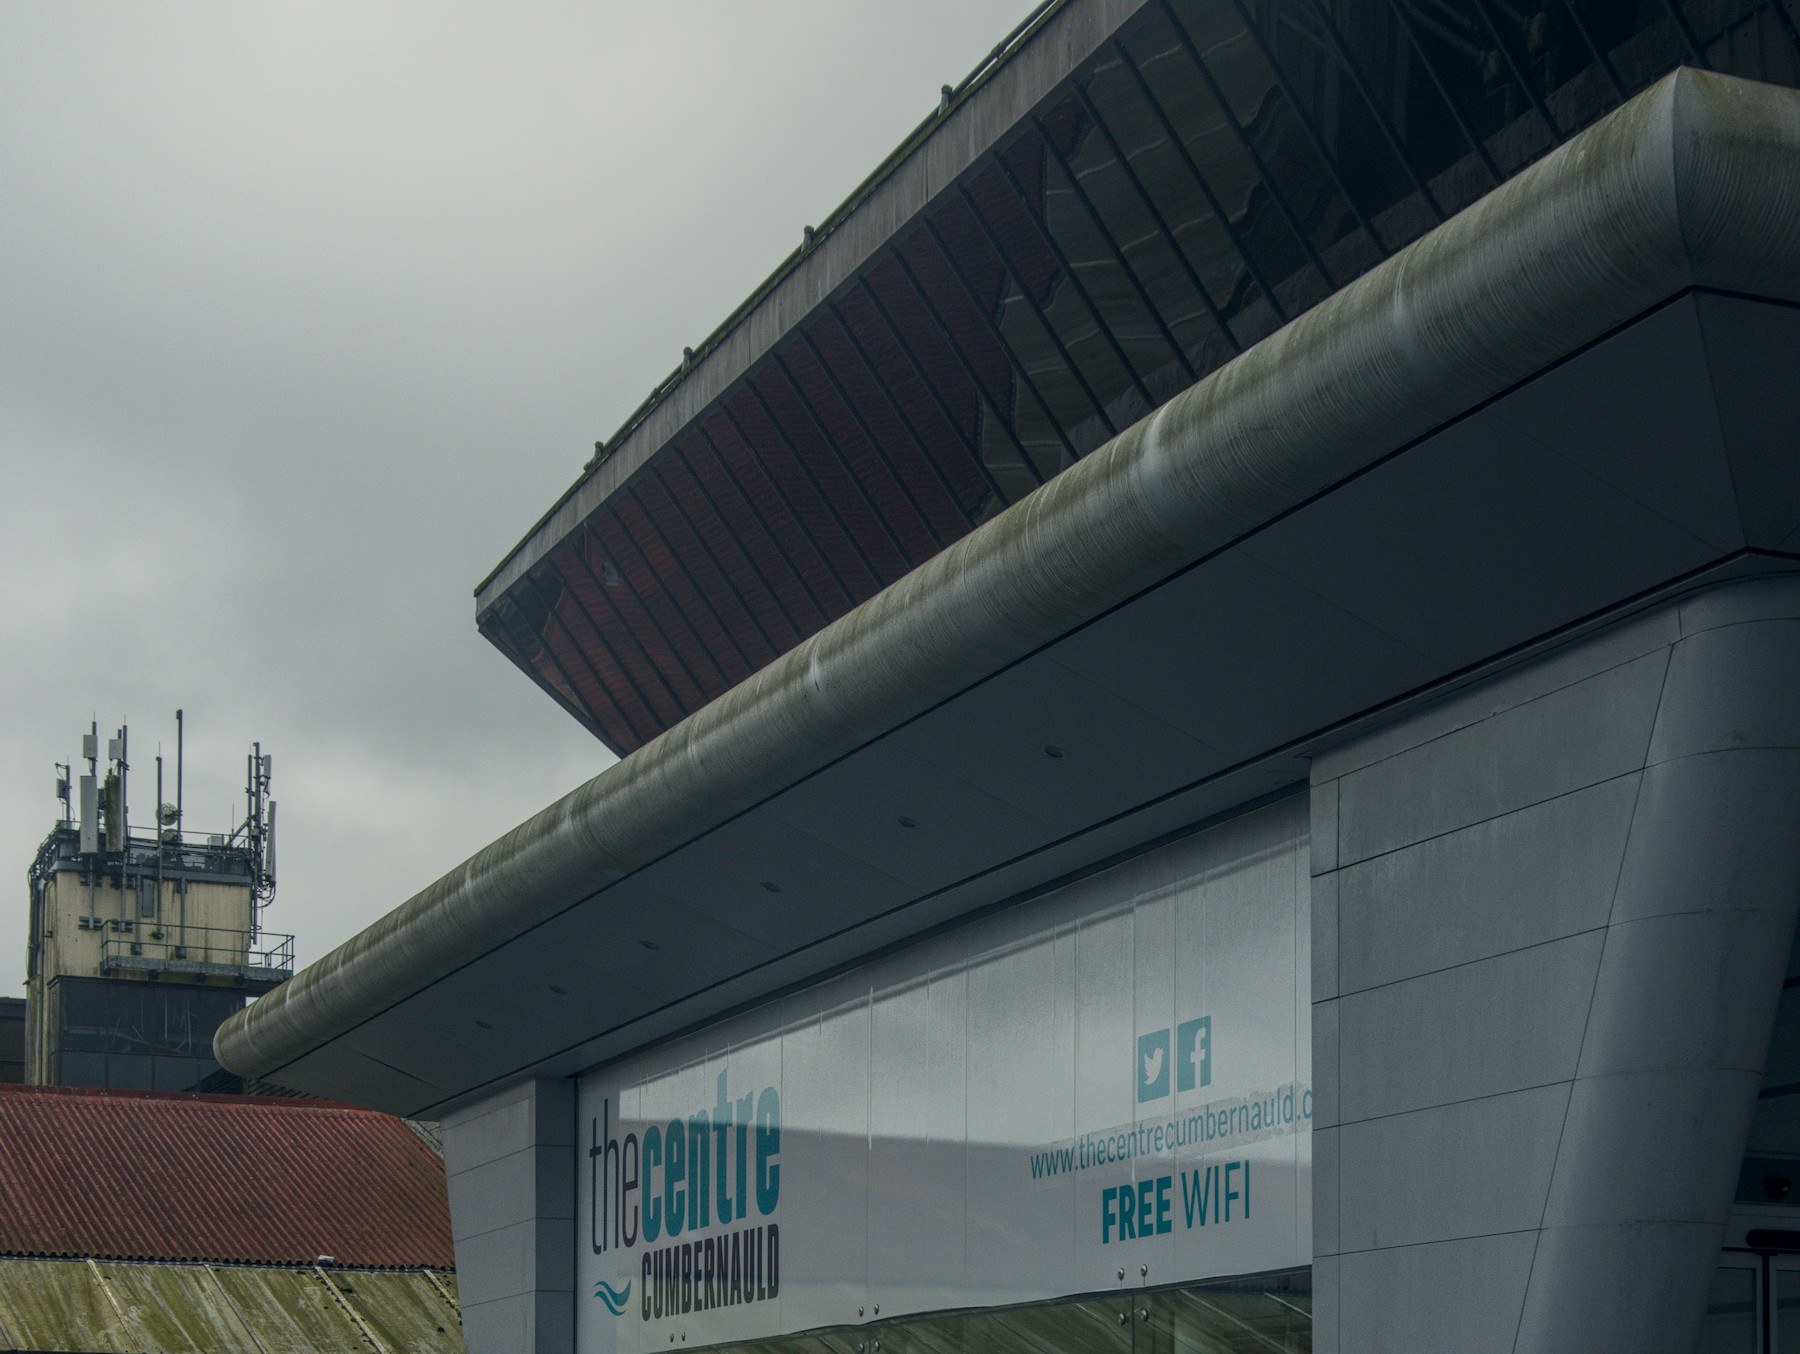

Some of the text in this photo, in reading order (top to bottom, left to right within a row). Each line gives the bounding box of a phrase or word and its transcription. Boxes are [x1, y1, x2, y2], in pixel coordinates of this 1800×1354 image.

[1102, 1160, 1251, 1244] FREE WIFI
[641, 1223, 780, 1321] CUMBERNAULD
